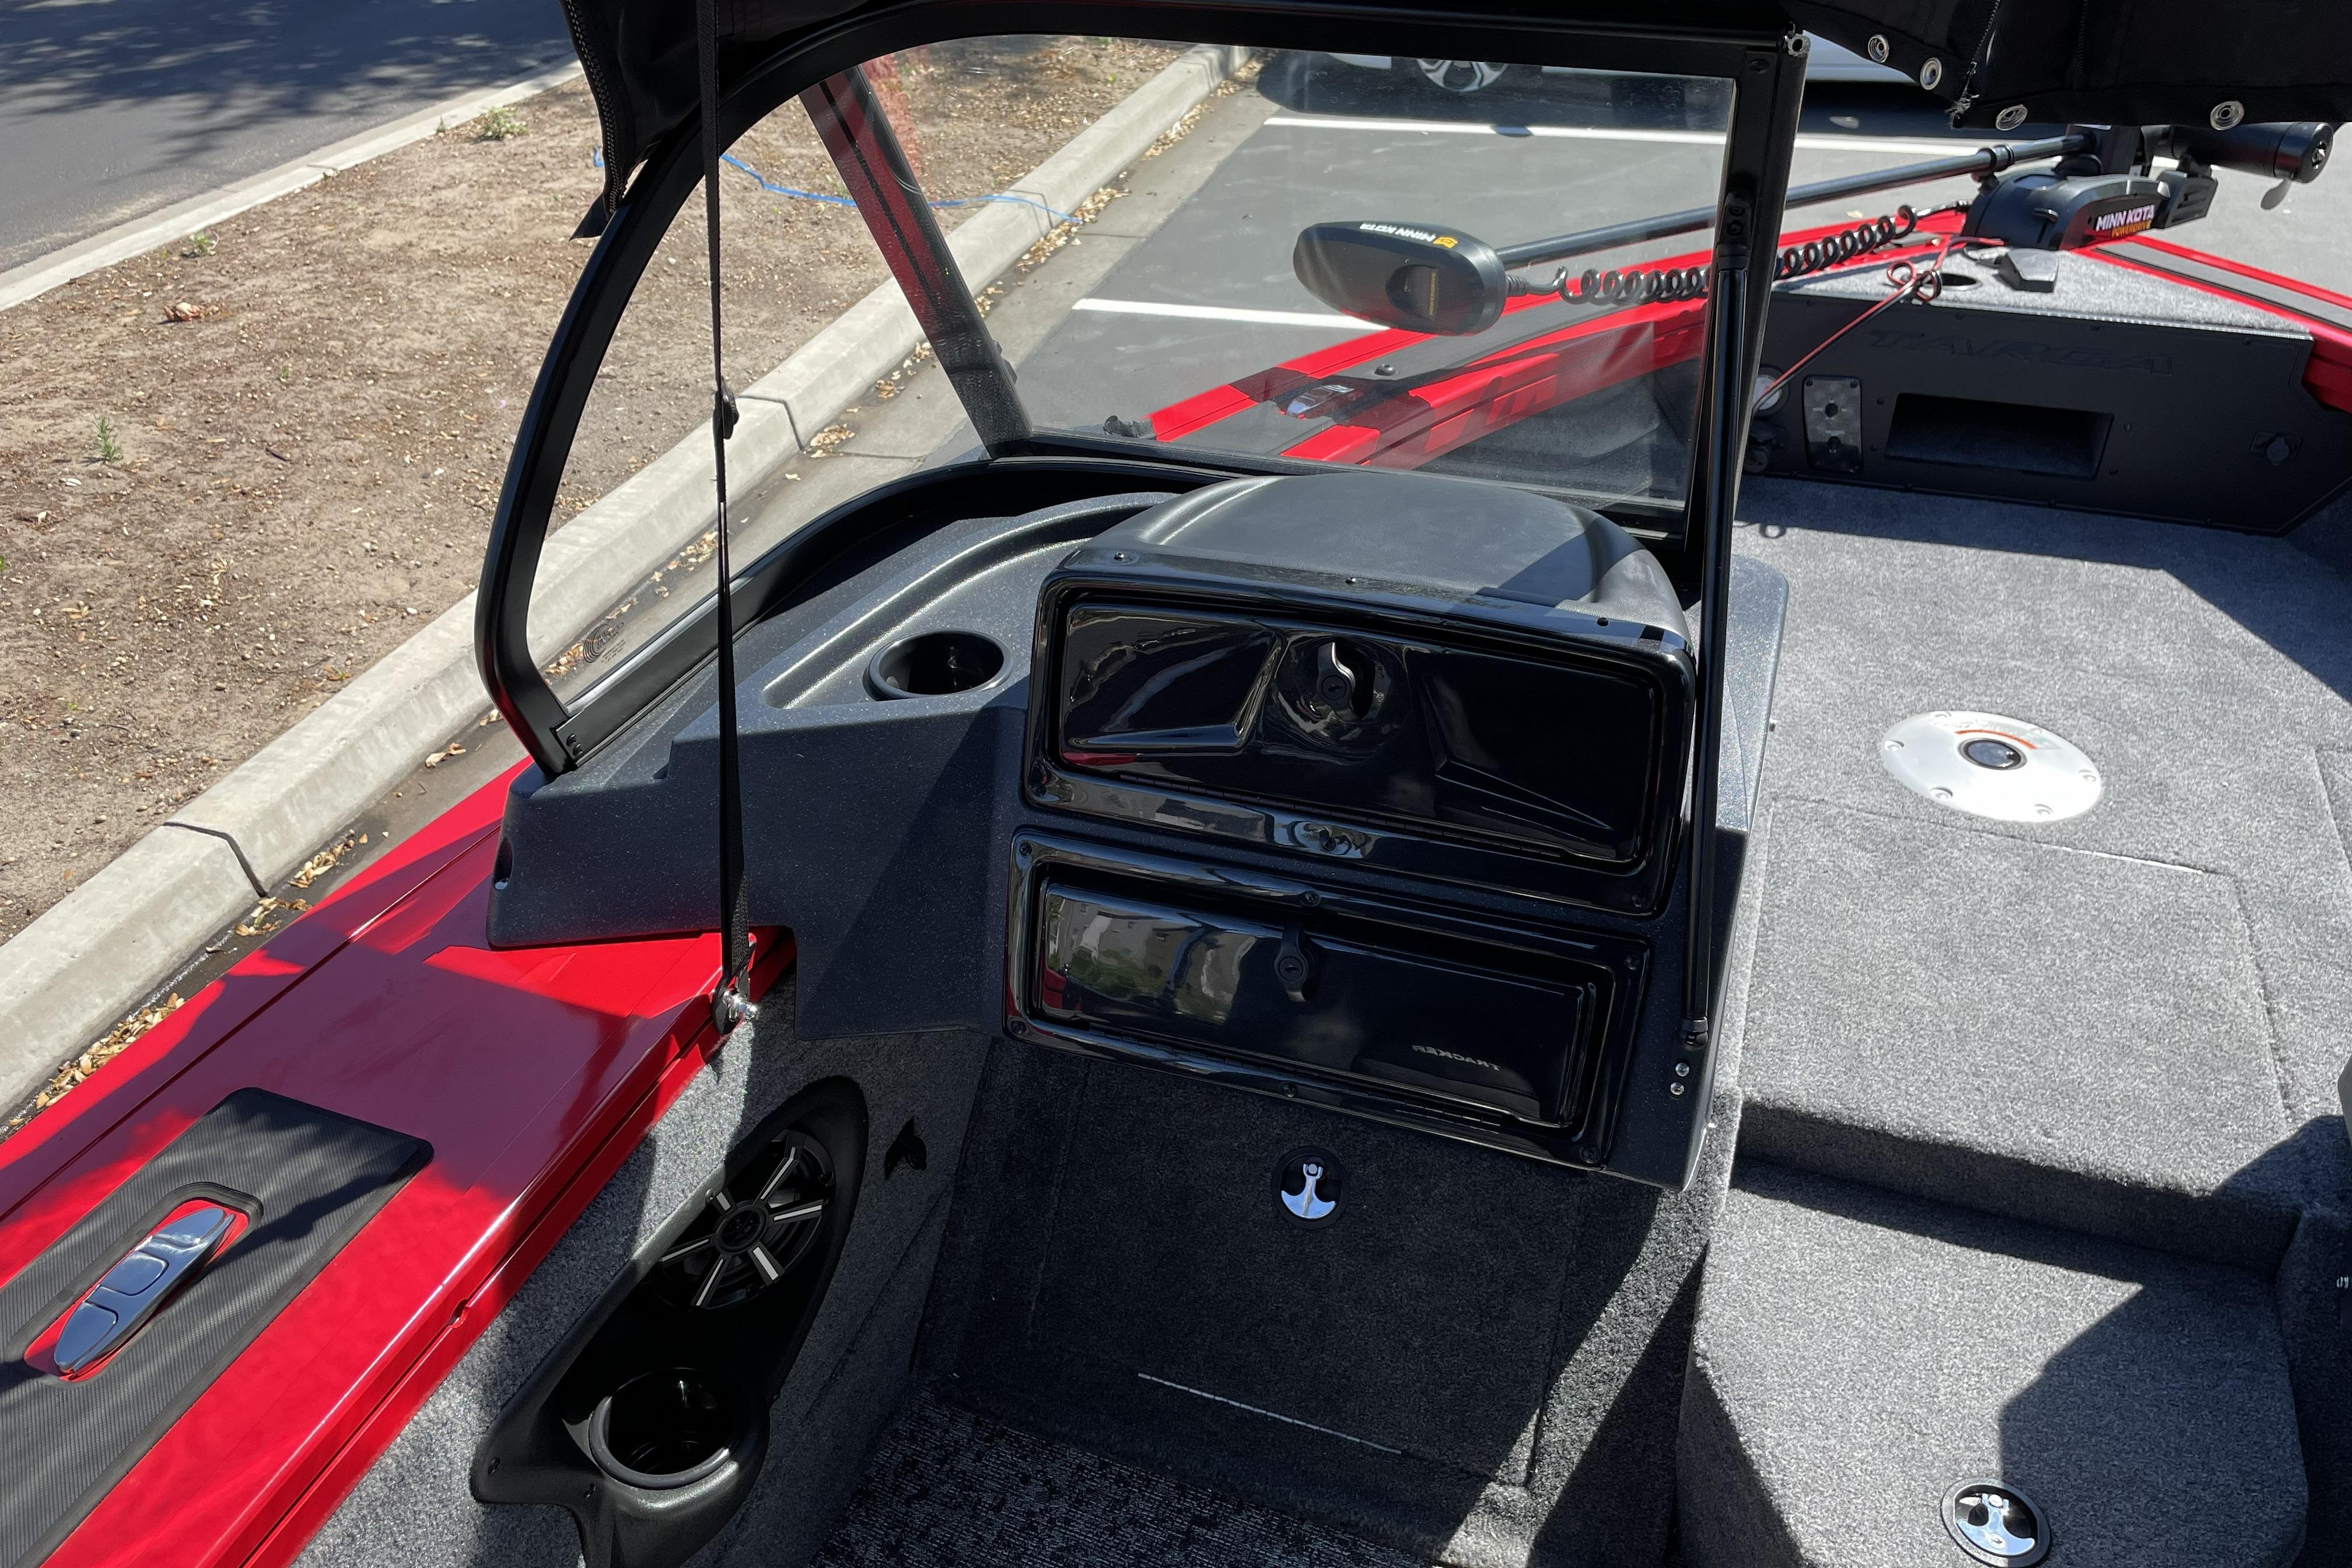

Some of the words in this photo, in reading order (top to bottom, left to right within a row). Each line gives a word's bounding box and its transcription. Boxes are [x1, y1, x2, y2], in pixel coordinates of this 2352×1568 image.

[1359, 223, 1397, 233] KOTA
[2095, 211, 2127, 232] MINN
[2126, 204, 2156, 225] KOTA
[1396, 227, 1436, 242] MINN
[1871, 330, 2174, 374] TARGA
